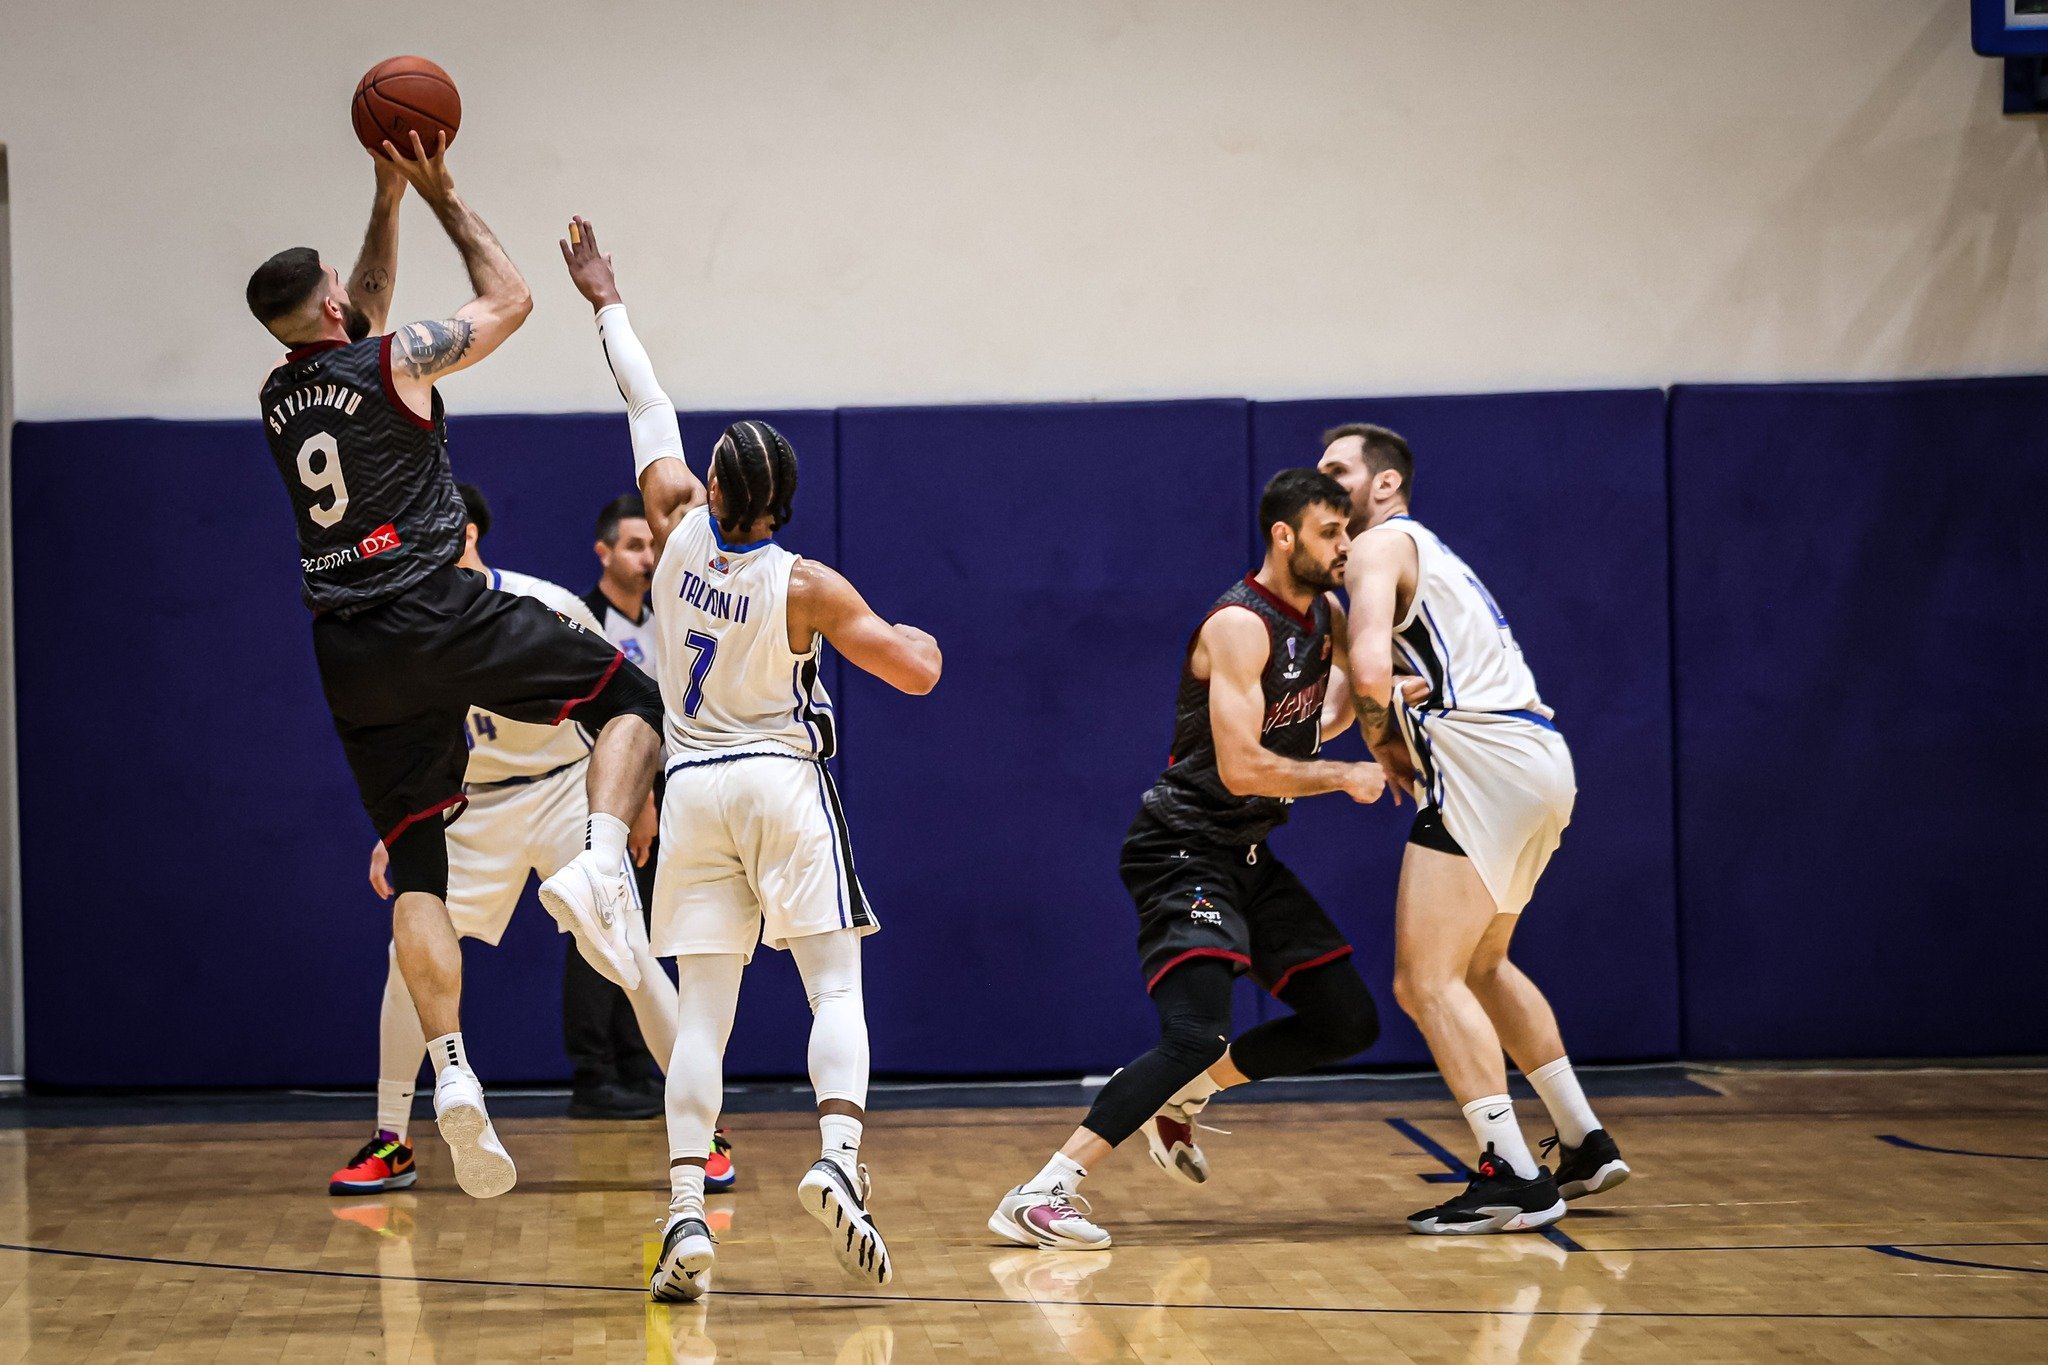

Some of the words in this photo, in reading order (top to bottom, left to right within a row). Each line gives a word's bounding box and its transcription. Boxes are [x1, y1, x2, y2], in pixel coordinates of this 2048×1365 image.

[269, 384, 363, 435] STYLIANOU
[296, 430, 349, 529] 9
[682, 628, 718, 719] 7
